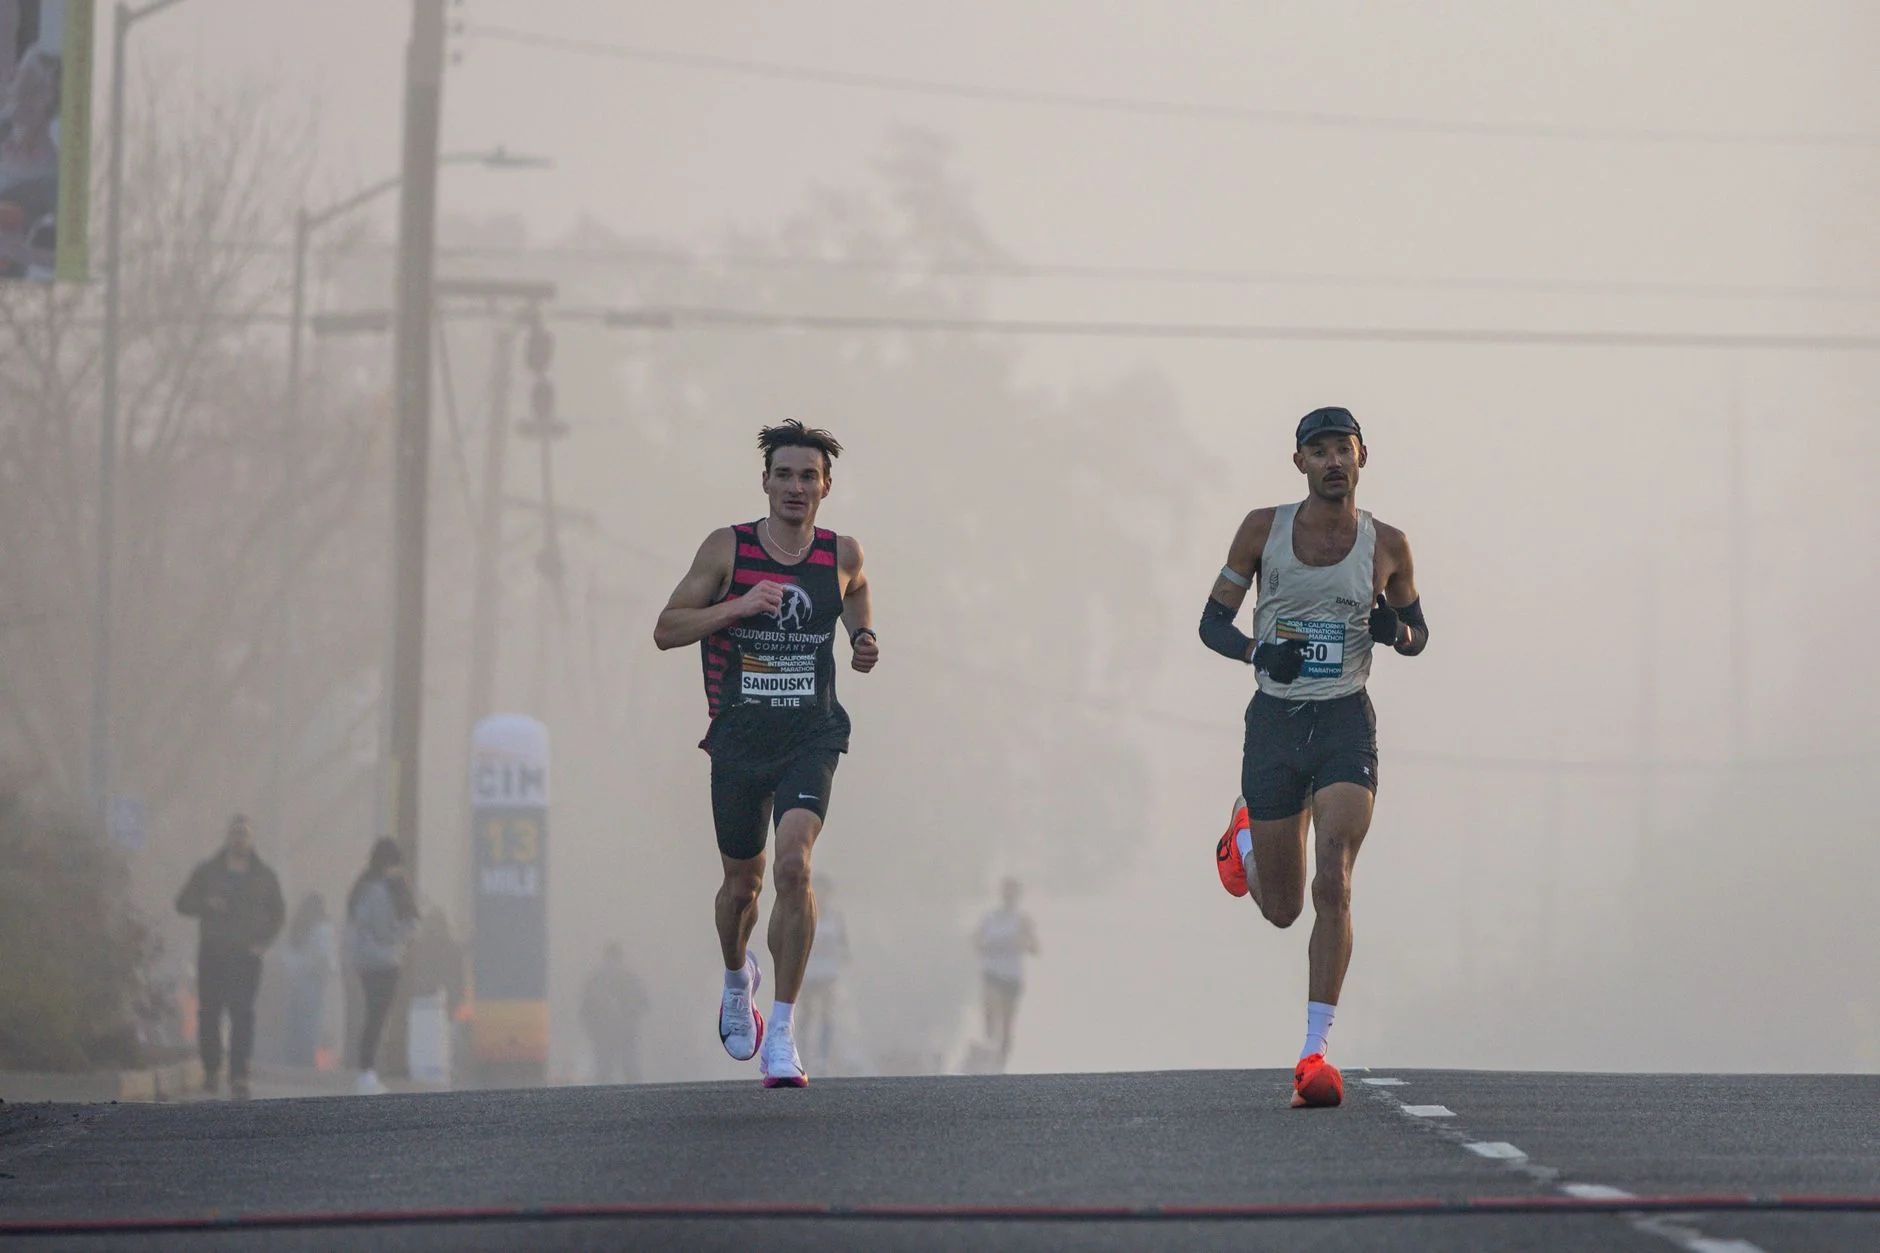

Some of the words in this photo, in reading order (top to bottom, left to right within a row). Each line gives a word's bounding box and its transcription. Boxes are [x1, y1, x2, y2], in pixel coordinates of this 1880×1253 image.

[1335, 596, 1360, 607] BANDIT
[728, 627, 785, 642] COLUMBUS
[1295, 627, 1344, 635] INTERNATIONAL
[1308, 633, 1344, 641] MARATHON
[754, 642, 807, 652] COMPANY
[743, 676, 814, 691] SANDUSKY
[770, 697, 801, 707] ELITE
[485, 819, 538, 863] 13
[482, 865, 538, 896] MILE
